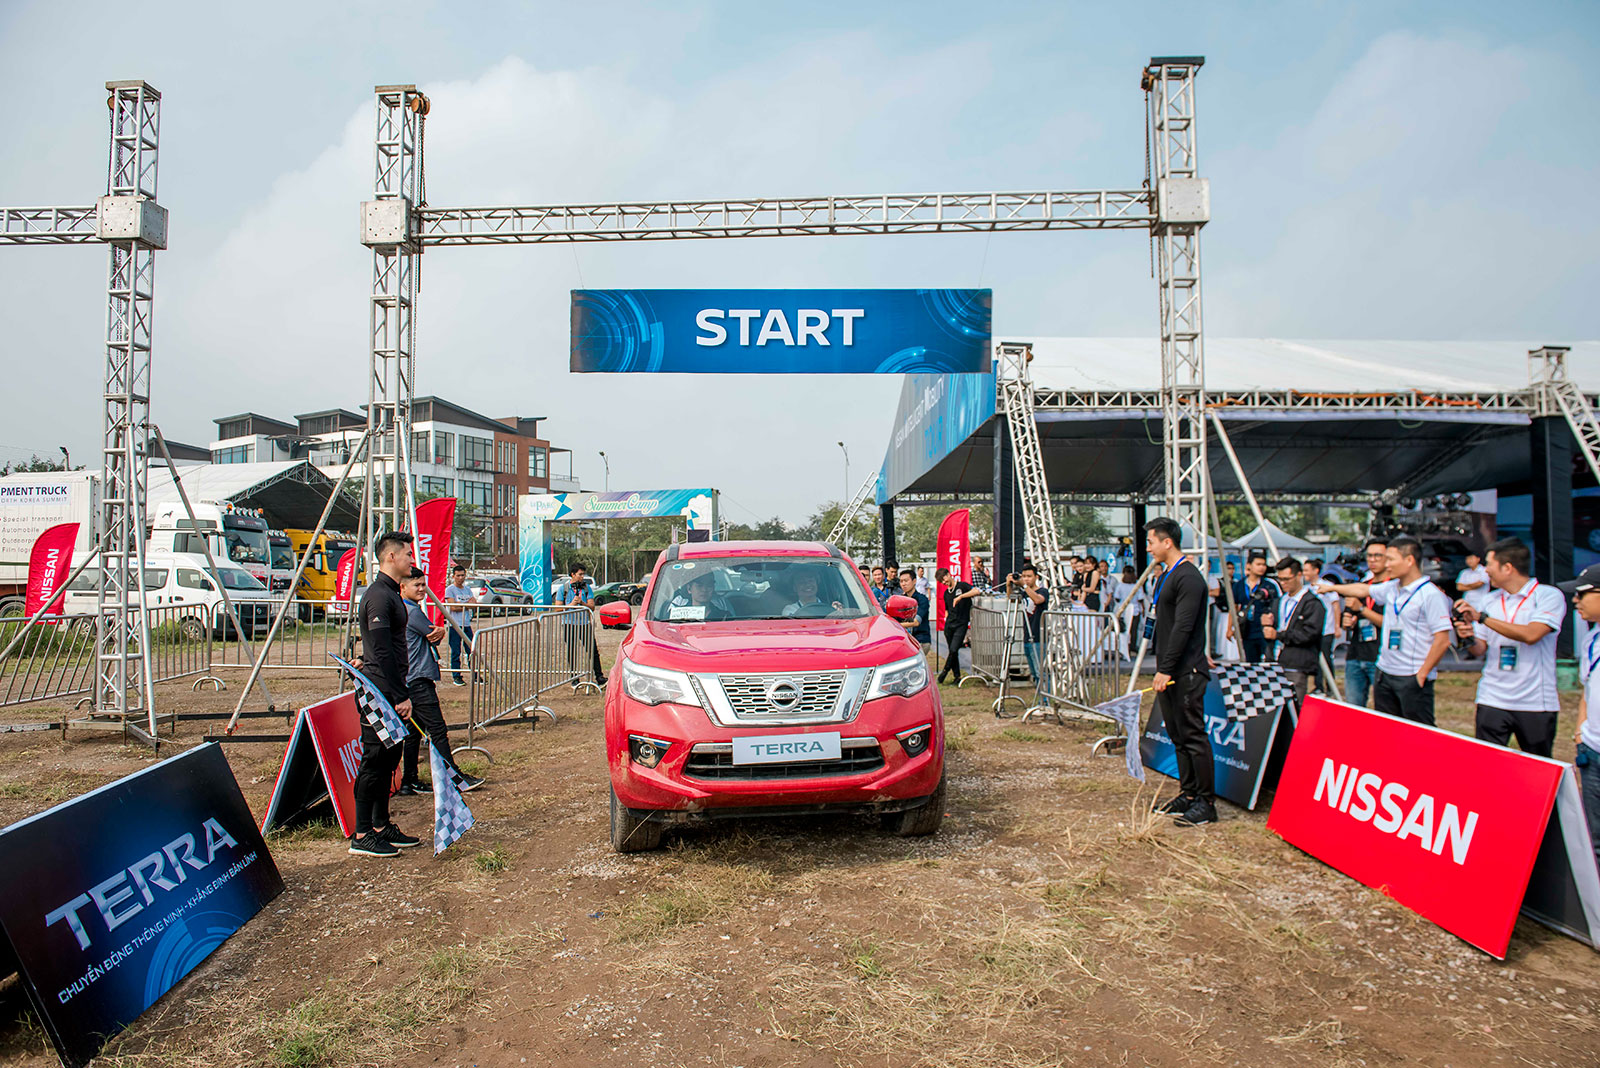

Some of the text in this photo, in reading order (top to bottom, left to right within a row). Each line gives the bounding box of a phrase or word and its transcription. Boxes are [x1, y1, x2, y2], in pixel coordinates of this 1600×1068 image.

[695, 308, 865, 347] START
[35, 486, 68, 496] TRUCK
[40, 549, 59, 601] NISSAN
[340, 562, 352, 597] NISSAN
[771, 692, 799, 700] NISSAN
[750, 741, 825, 756] TERRA
[1313, 757, 1480, 866] NISSAN
[44, 816, 239, 951] TERRA
[58, 964, 105, 1004] CHUYỂN
[103, 943, 134, 971] ĐỘNG
[131, 917, 165, 949] THÔNG
[162, 905, 186, 927] MINH
